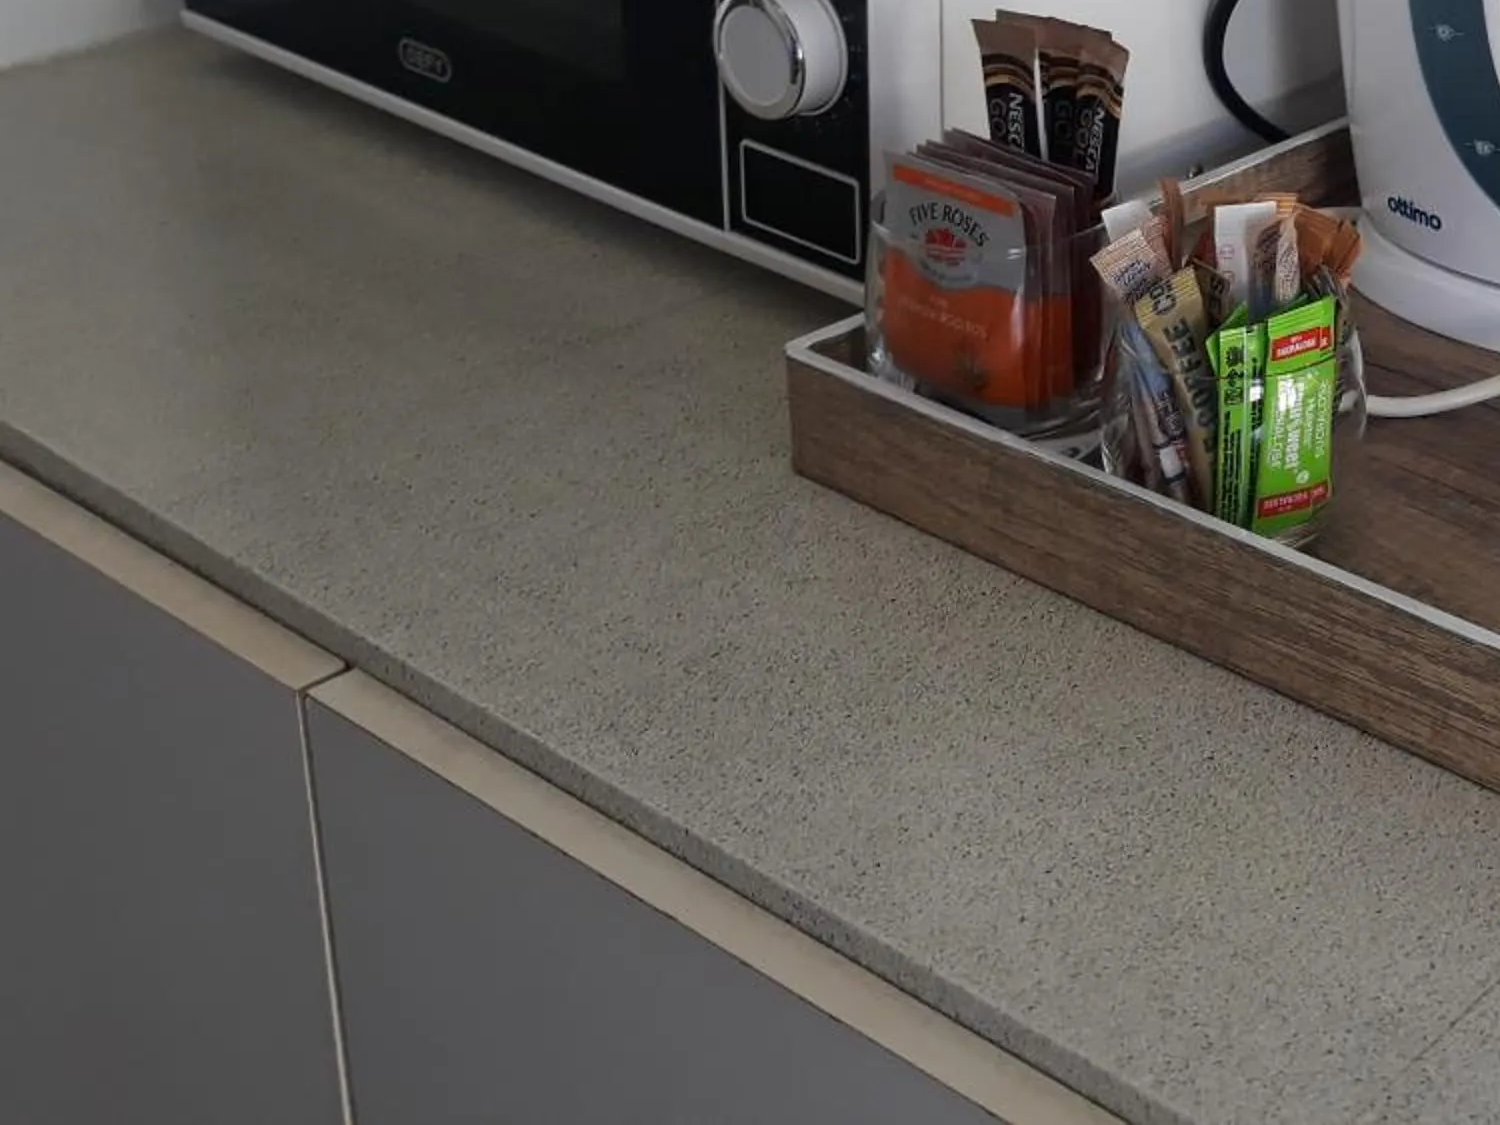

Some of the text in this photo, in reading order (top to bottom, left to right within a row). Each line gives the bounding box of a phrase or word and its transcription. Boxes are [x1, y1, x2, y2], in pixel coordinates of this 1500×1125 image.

[989, 97, 1007, 138] GO
[1006, 92, 1025, 153] NESC
[1083, 106, 1105, 171] NESCA
[909, 201, 990, 247] FIVE ROSES
[1387, 195, 1443, 231] ottimo
